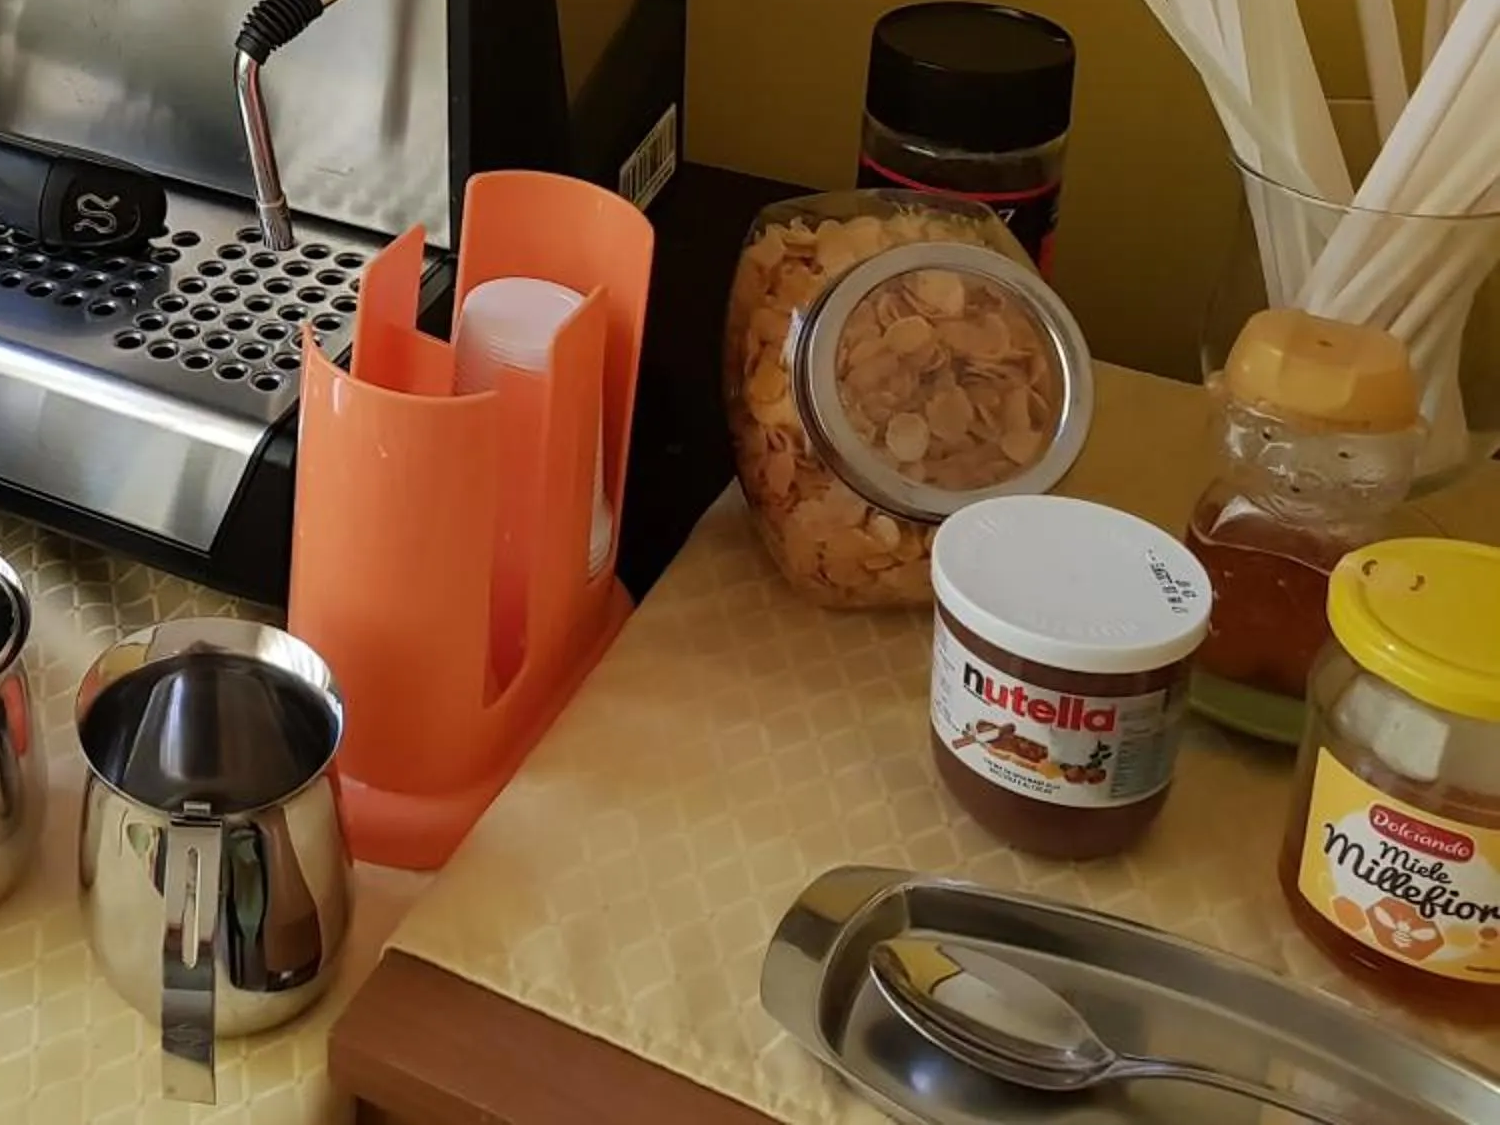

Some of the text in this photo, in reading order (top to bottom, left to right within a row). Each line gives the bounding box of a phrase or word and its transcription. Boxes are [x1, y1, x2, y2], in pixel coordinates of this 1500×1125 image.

[963, 662, 1116, 732] nutella
[1372, 810, 1471, 858] Dolciando
[1379, 841, 1453, 884] Miele
[1323, 822, 1500, 924] Millefior
